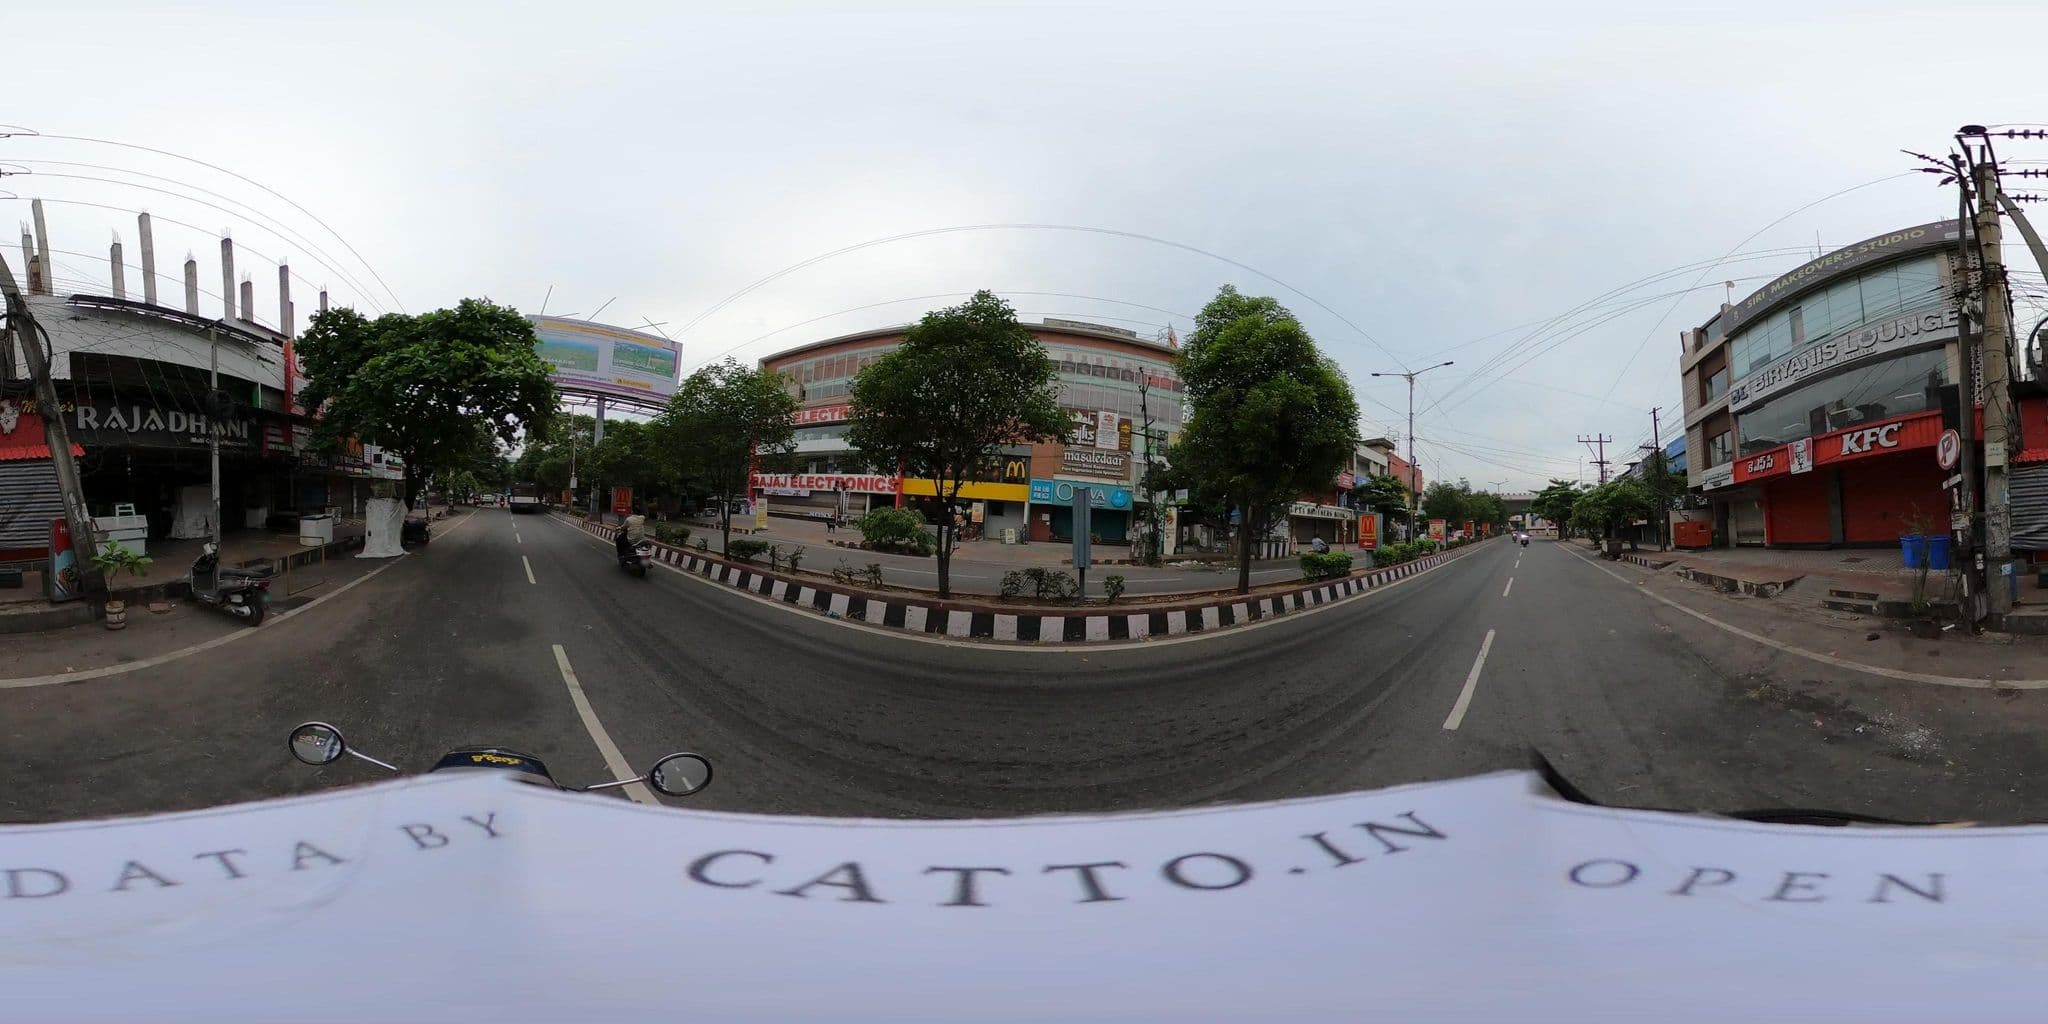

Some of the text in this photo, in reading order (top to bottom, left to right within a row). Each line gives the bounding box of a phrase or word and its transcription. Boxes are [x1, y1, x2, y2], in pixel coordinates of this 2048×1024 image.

[1746, 290, 1766, 307] SIRI
[1770, 249, 1854, 292] MAKEOVERS
[1858, 228, 1926, 256] STUDIO
[1754, 310, 1960, 393] BIRYANIS LOUNGE
[77, 406, 248, 438] RAJADHANI
[1841, 423, 1902, 456] KFC
[1064, 449, 1124, 466] masaledaar
[790, 476, 898, 492] ELECTRONICS
[2, 810, 1450, 906] DATA BY CATTO.IN
[1567, 857, 1948, 904] OPEN
